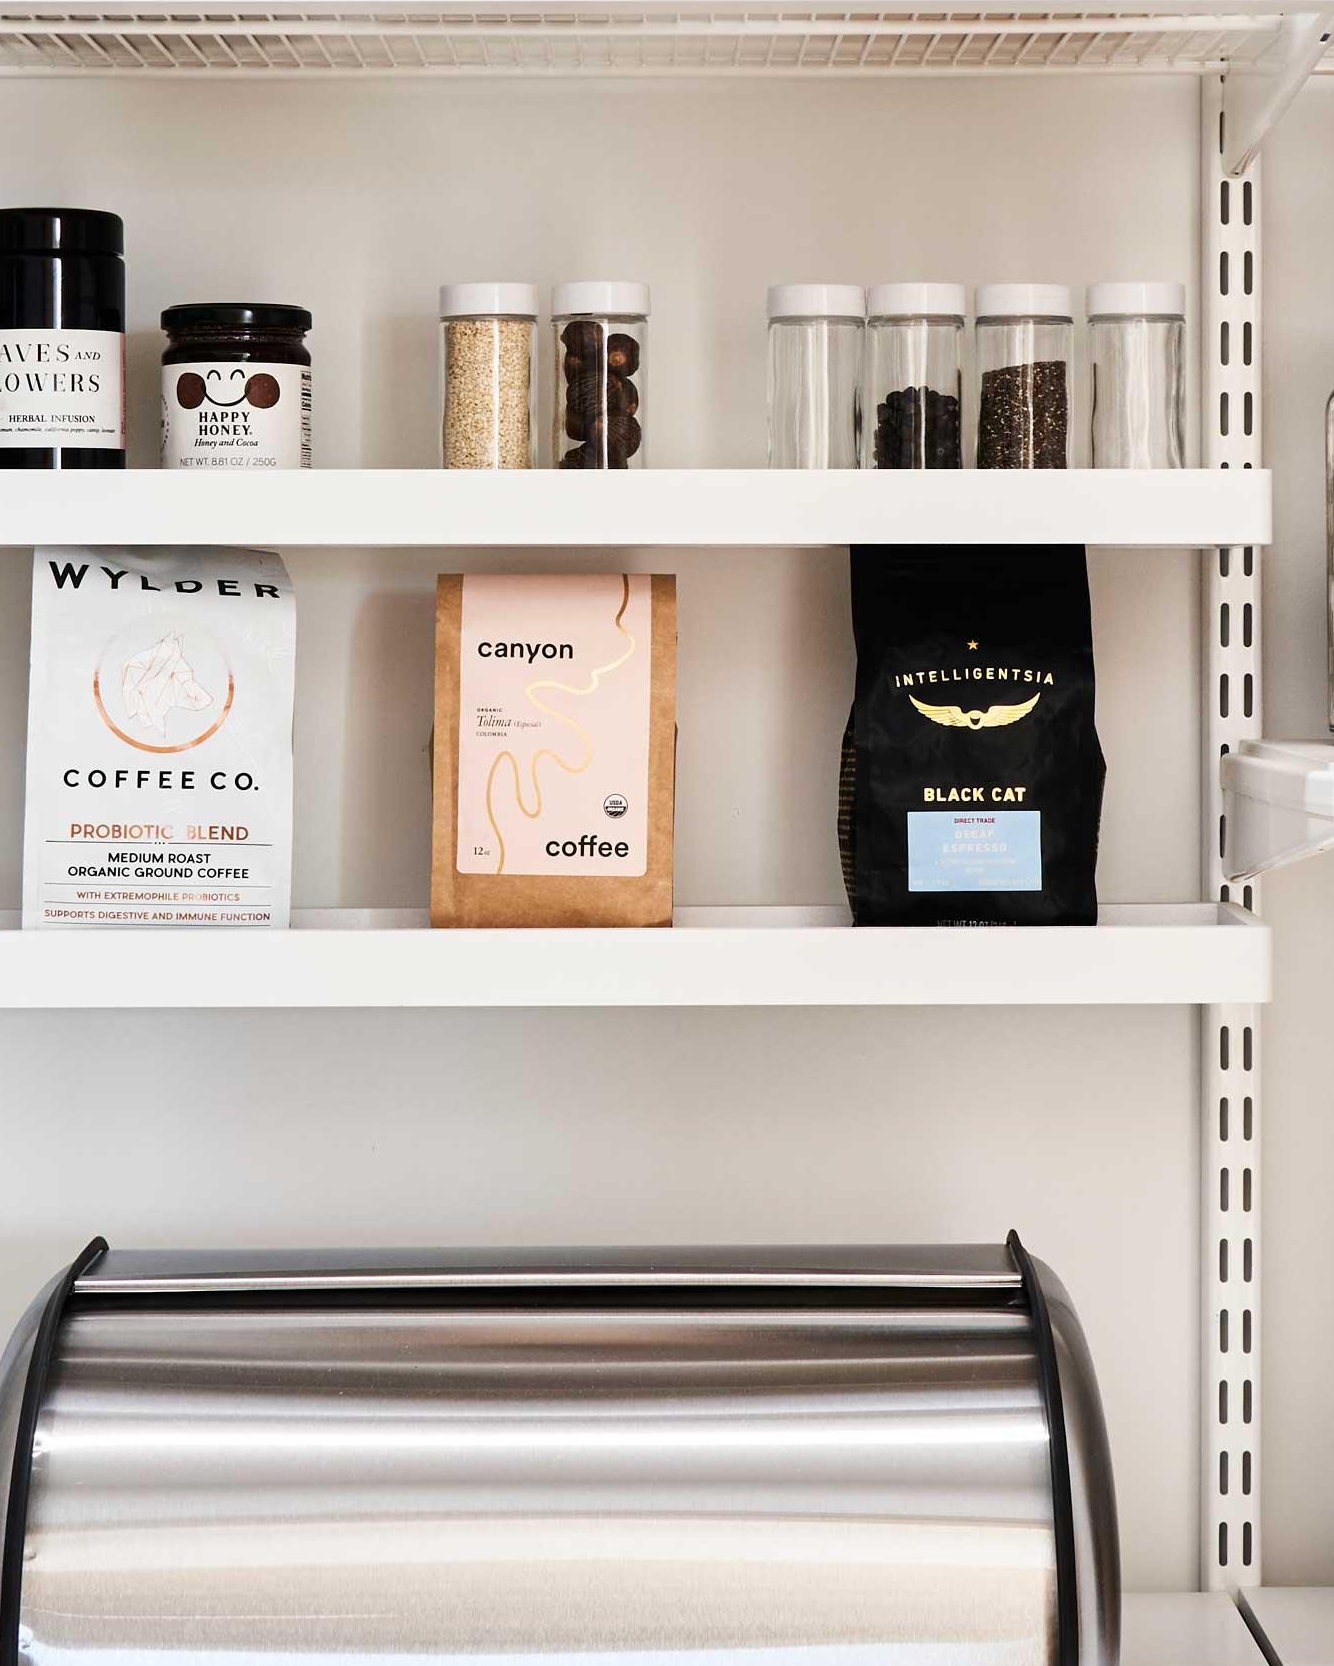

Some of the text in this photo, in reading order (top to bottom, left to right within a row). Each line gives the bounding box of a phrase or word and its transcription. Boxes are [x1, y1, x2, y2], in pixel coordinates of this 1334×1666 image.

[75, 351, 101, 361] AND
[9, 414, 96, 423] HERBAL INFUSION
[199, 412, 250, 423] HAPPY
[199, 425, 251, 436] HONEY
[194, 438, 217, 449] Honey
[236, 438, 258, 446] Cocoa
[230, 458, 244, 466] OZ
[48, 560, 280, 599] WYLDER
[477, 640, 574, 664] canyon
[895, 667, 1055, 689] INTELLIGENTSIA
[477, 715, 511, 727] Tolima
[63, 769, 259, 792] COFFEE CO.
[924, 787, 1026, 802] BLACK CAT
[70, 824, 249, 841] PROBIOTIC BLEND
[473, 847, 484, 855] 12
[546, 835, 629, 857] coffee
[108, 853, 211, 864] MEDIUM ROAST
[68, 867, 249, 879] ORGANIC GROUND COFFEE
[77, 891, 240, 901] WITH EXTREMOPHILE PROBIOTICS
[45, 909, 270, 921] SUPPORTS DIGESTIVE AND IMMUNE FUNCTION
